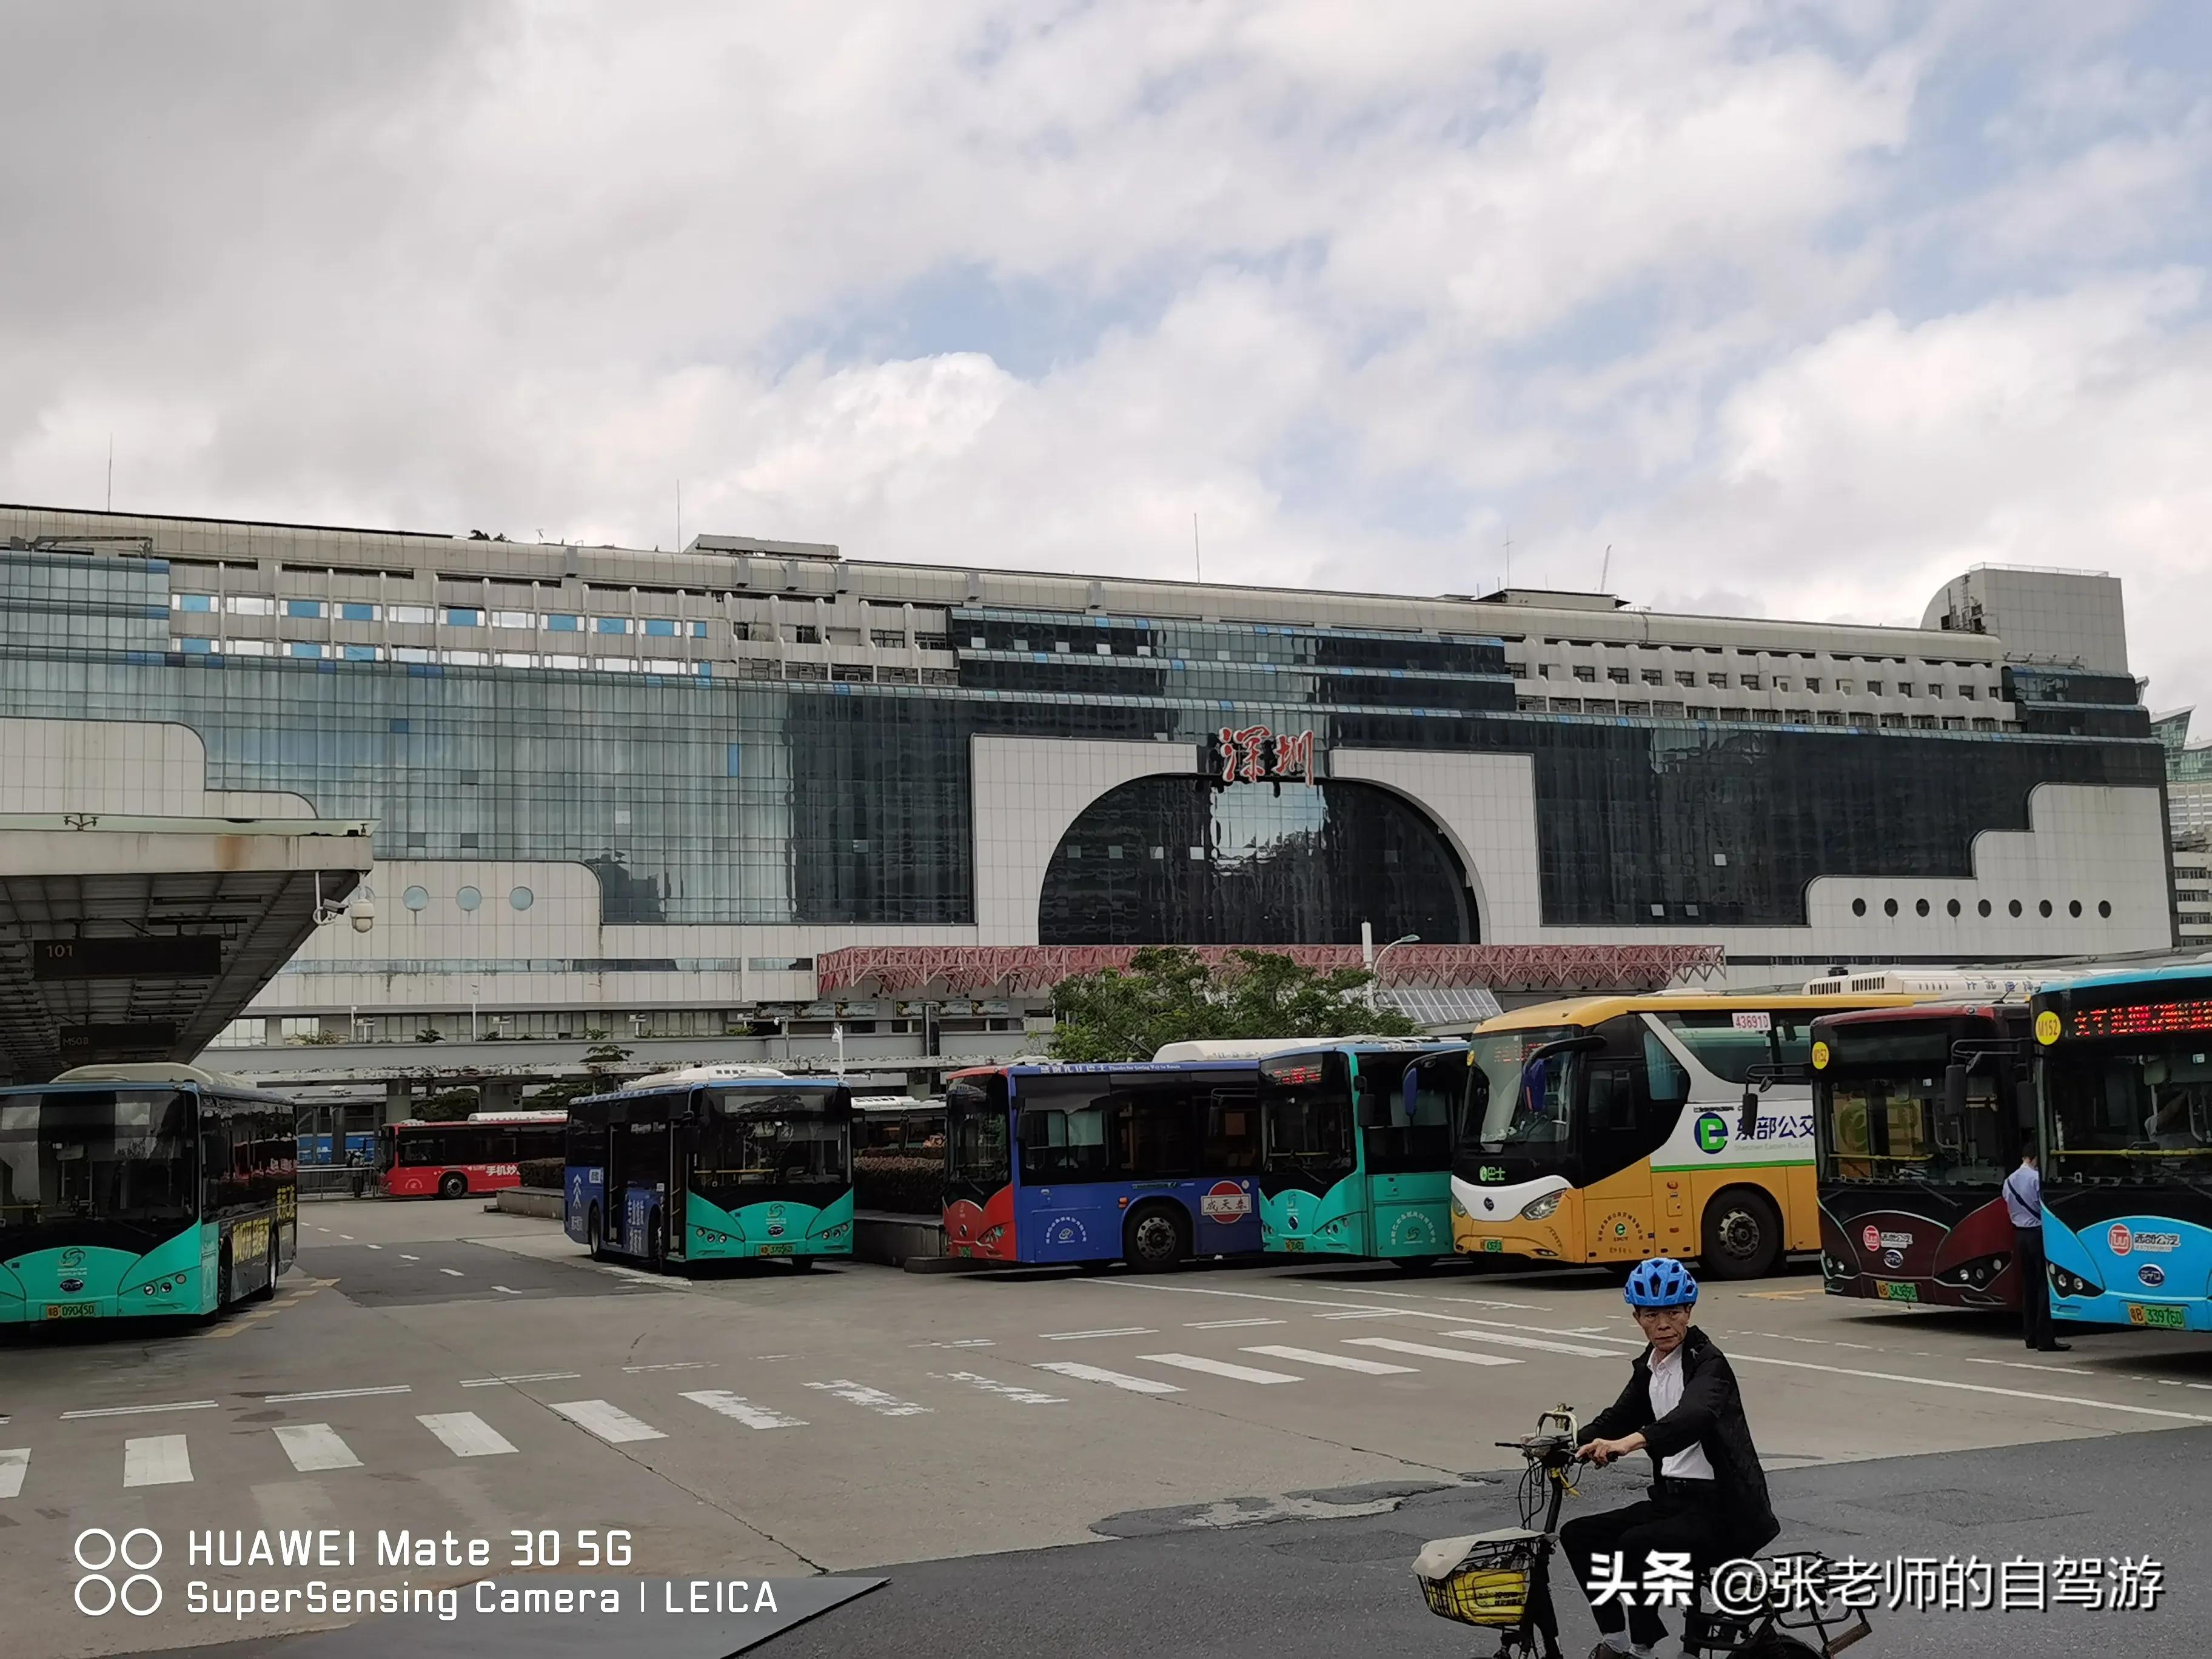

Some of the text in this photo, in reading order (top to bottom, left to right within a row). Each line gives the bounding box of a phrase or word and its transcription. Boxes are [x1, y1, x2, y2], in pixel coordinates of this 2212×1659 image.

[1219, 725, 1314, 786] 深圳
[45, 944, 73, 958] 101
[2038, 1019, 2058, 1036] M152
[486, 1164, 521, 1176] 手机炒
